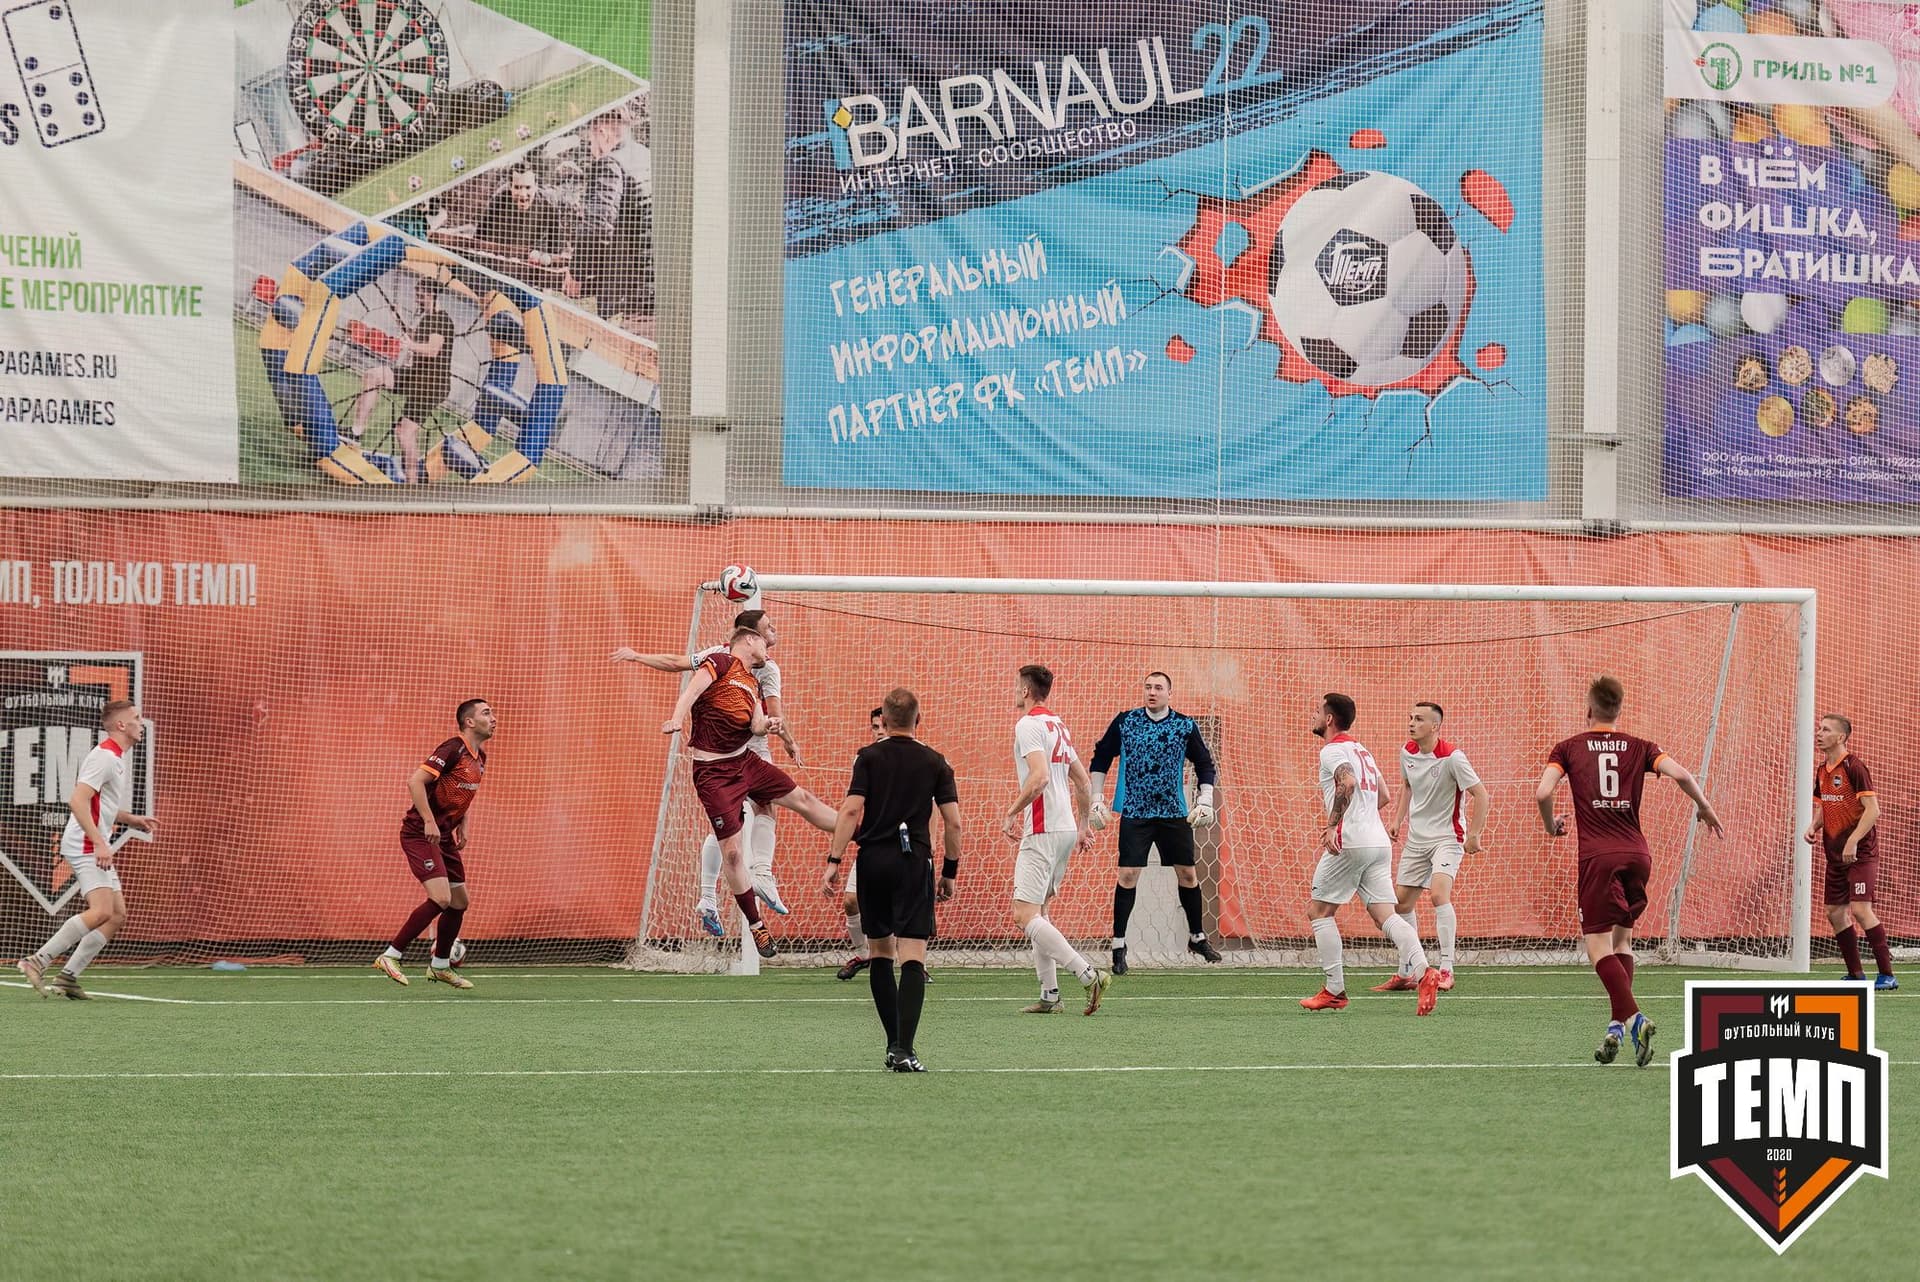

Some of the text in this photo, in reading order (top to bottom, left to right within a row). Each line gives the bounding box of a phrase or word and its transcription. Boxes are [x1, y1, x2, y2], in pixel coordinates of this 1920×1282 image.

[1753, 59, 1878, 84] ГРИЛЬ №1
[839, 154, 957, 194] ИНТЕРНЕТ
[978, 119, 1137, 168] СООБЩЕСТВО
[1699, 145, 1827, 191] В ЧЁМ
[1699, 201, 1877, 245] ФИШКА,
[0, 231, 82, 269] ЧЕНИЙ
[1699, 247, 1920, 286] БРАТИШКА
[829, 233, 1047, 317] ГЕНЕРАЛЬНЫЙ
[22, 279, 204, 317] МЕРОПРИЯТИЕ
[830, 280, 1126, 383] ИНФОРМАЦИОННЫЙ
[828, 346, 1148, 444] ПАРТНЕР ФК «ТЕМП»
[1702, 452, 1729, 462] ООО
[51, 560, 163, 606] ТОЛЬКО
[172, 562, 256, 606] ТЕМП!
[5, 688, 75, 708] ФУТБОЛЬНЫЙ
[1586, 739, 1628, 752] КНЯЗЕВ
[1598, 752, 1619, 798] 6
